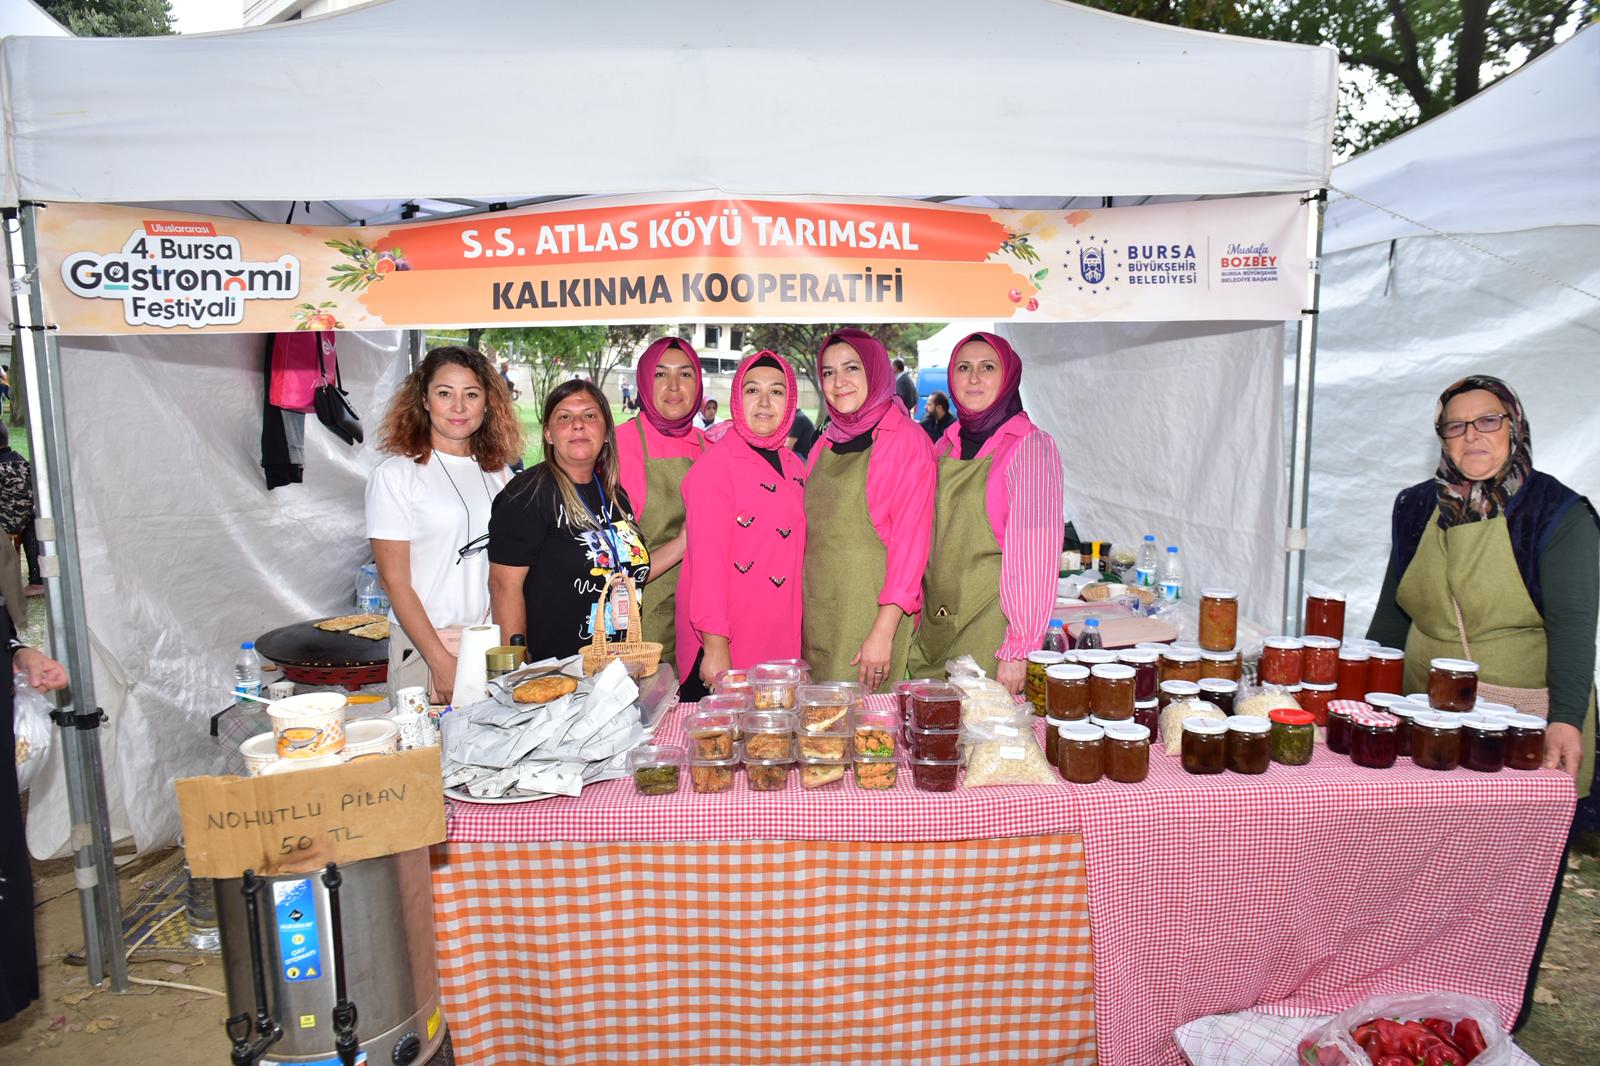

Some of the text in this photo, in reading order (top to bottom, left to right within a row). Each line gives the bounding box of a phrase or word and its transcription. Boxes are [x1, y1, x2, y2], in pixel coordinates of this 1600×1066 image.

[151, 223, 210, 235] Uluslararası
[461, 208, 920, 259] S.S. ATLAS KÖYÜ TARIMSAL
[131, 237, 233, 260] 4. Bursa
[1127, 245, 1197, 260] BURSA
[1226, 242, 1270, 257] Mustafa
[1128, 260, 1197, 273] BÜYÜKŞEHİR
[1220, 255, 1278, 269] BOZBEY
[1128, 271, 1197, 285] BELEDİYESİ
[492, 266, 904, 310] KALKINMA KOOPERATİFİ
[132, 296, 237, 321] Festivali
[207, 784, 406, 830] NOHUTLU PİLAV
[279, 826, 364, 856] 50 TL
